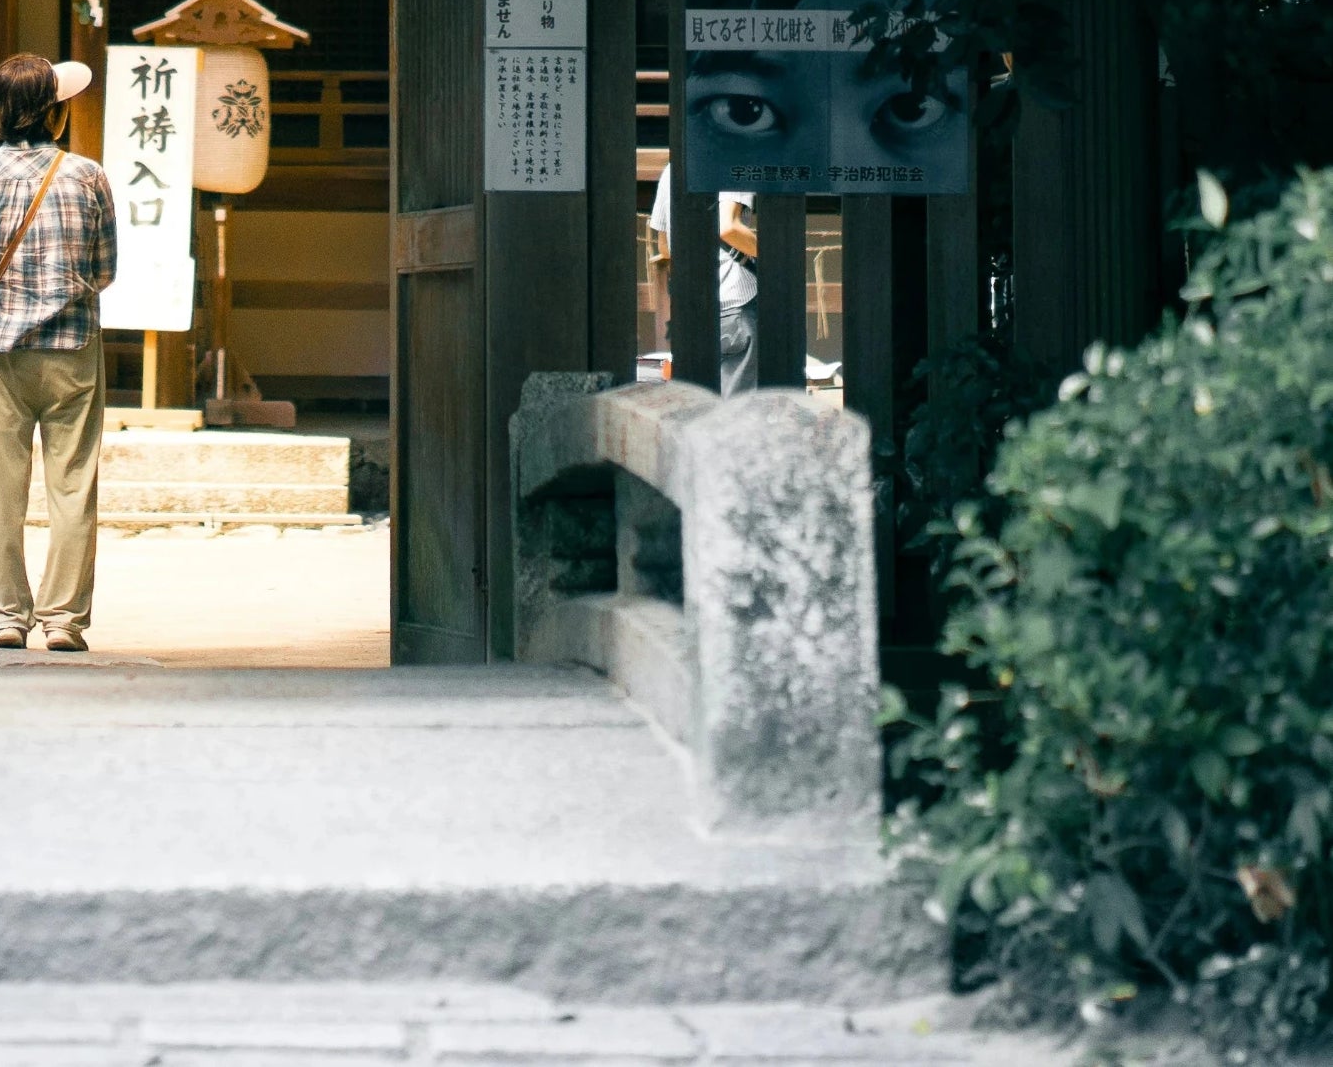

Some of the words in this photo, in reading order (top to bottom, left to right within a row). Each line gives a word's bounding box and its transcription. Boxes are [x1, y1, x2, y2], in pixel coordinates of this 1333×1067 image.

[567, 56, 577, 84] 御注意
[127, 55, 178, 227] 祈祷入口
[731, 165, 925, 183] 宇治警察署・宇治防犯協会
